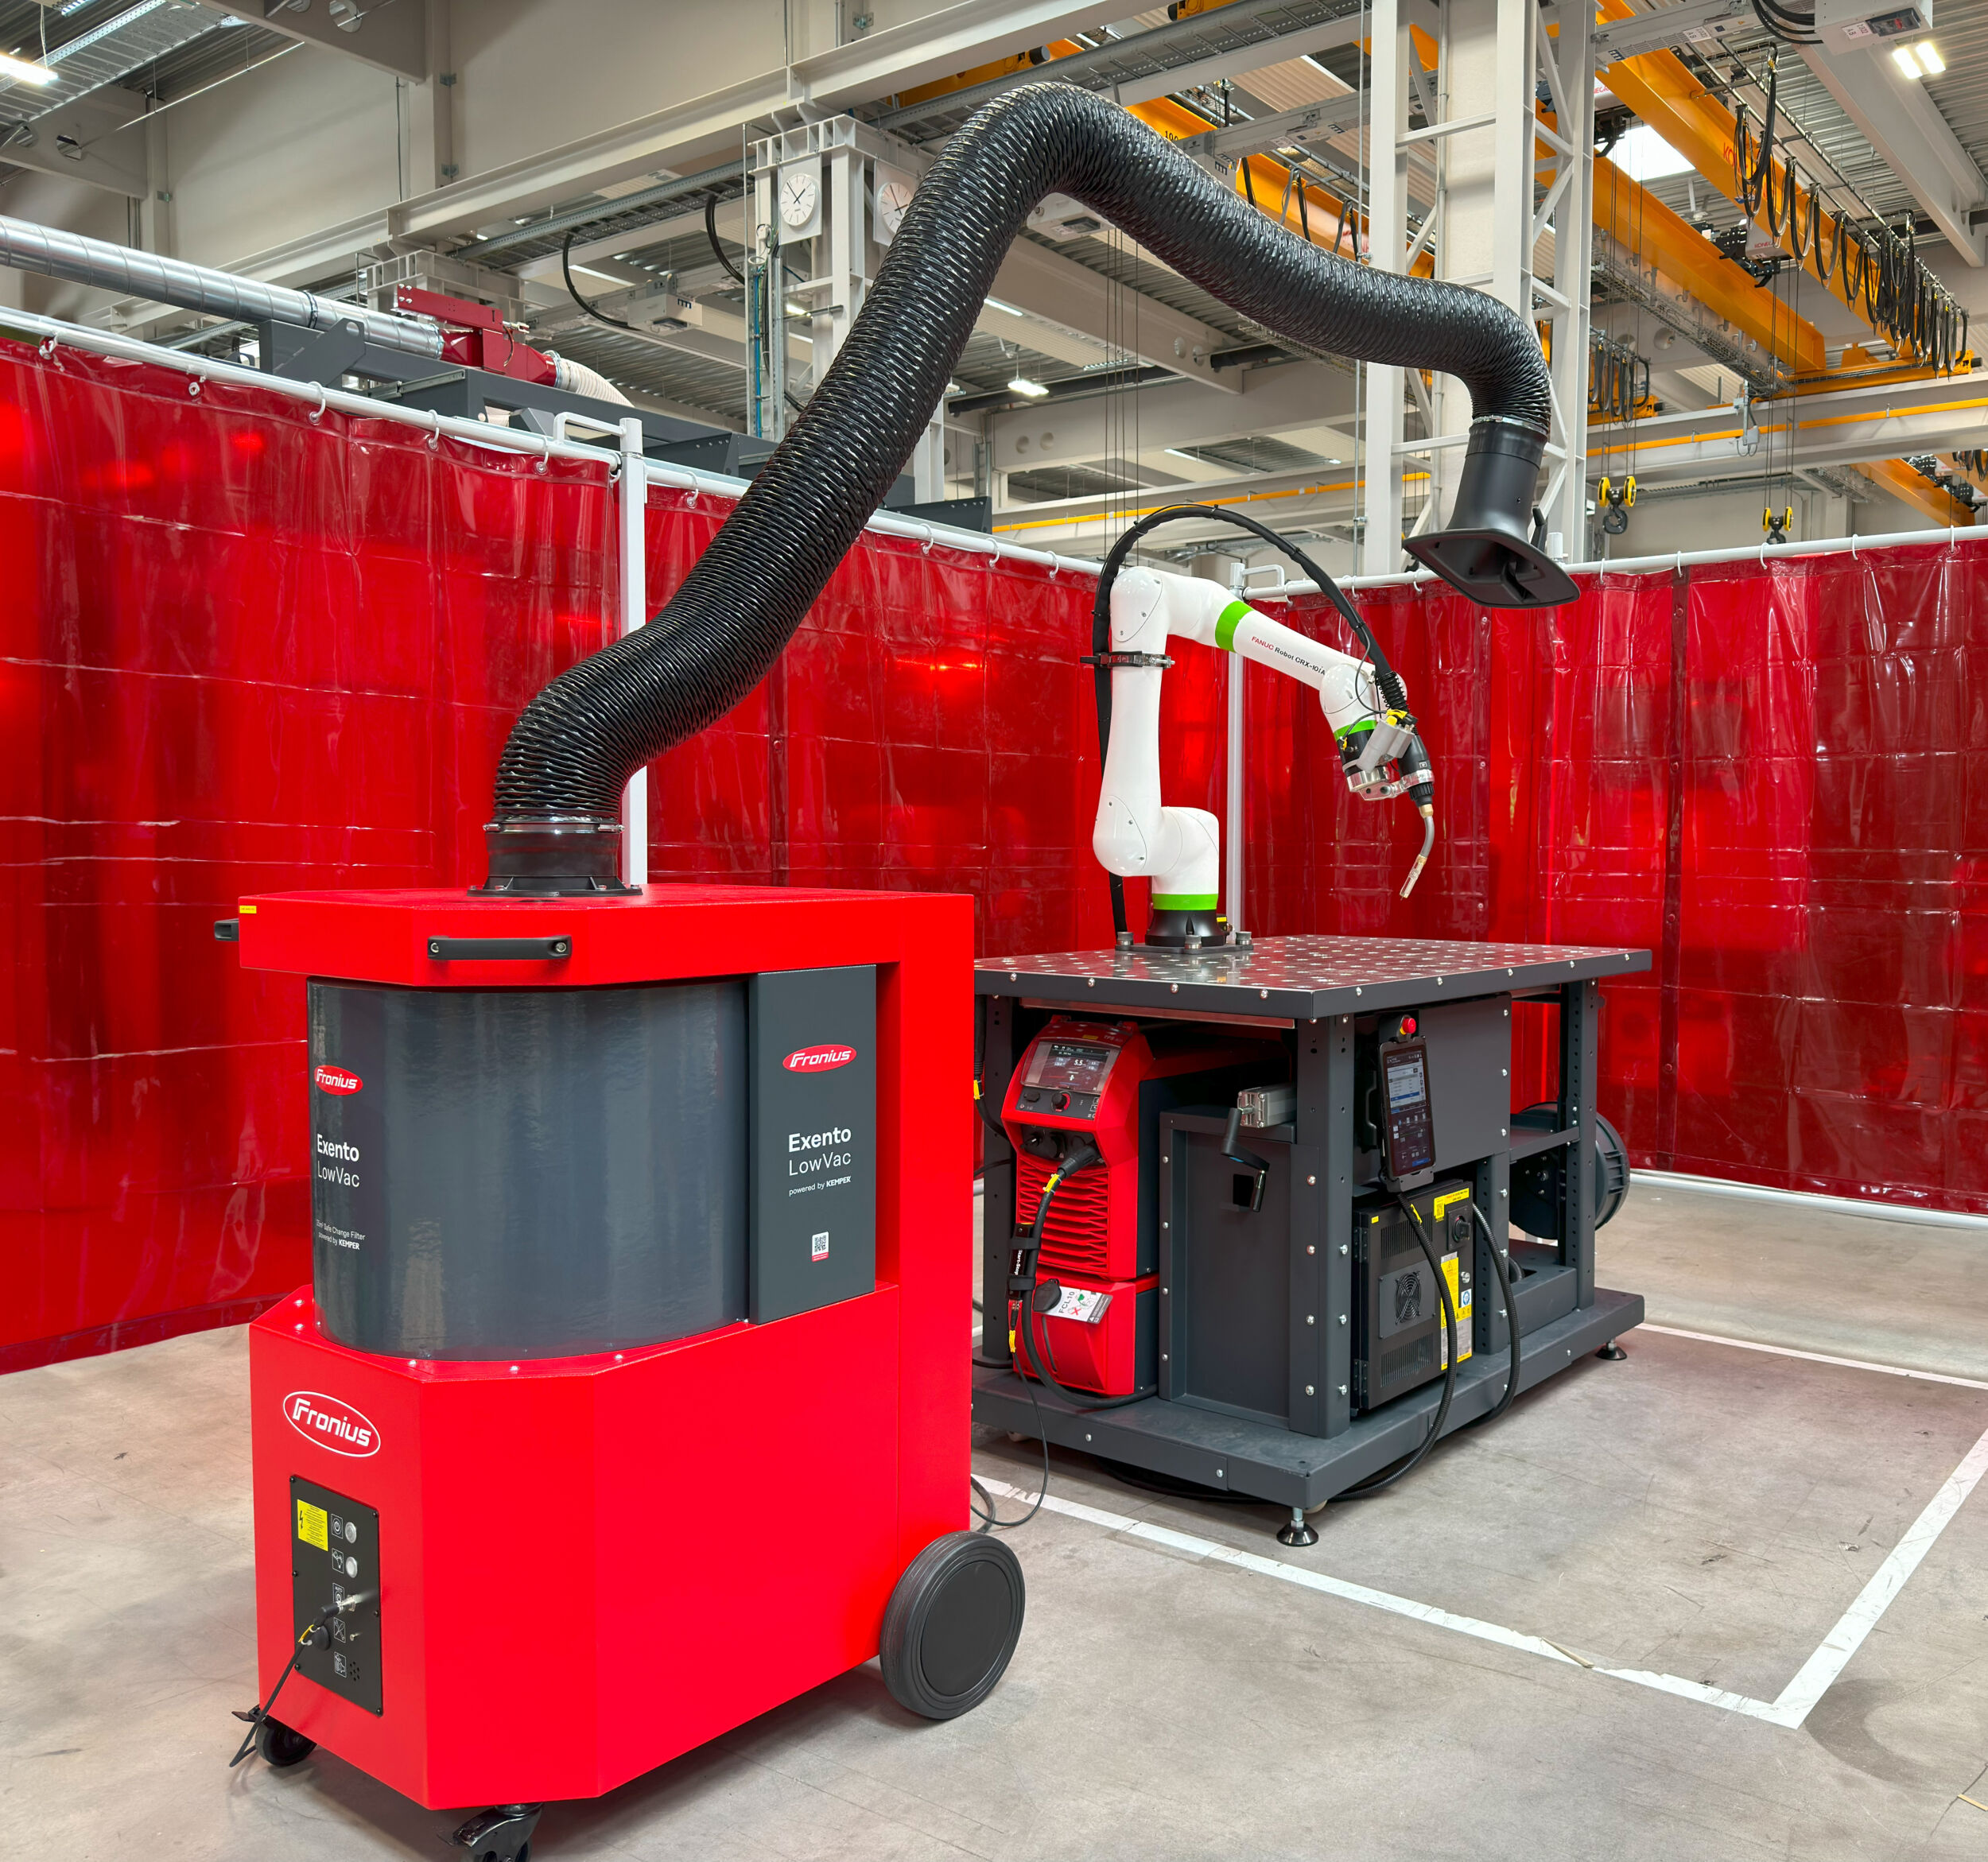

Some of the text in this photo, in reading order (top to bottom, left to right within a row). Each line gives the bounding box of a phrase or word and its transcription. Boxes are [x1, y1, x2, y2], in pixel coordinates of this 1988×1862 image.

[1251, 636, 1274, 650] FANUC
[1274, 646, 1295, 661] Robot
[789, 1049, 852, 1068] Fronius
[316, 1069, 358, 1089] Fronius
[316, 1133, 359, 1162] Exento
[789, 1127, 852, 1153] Exento
[317, 1160, 360, 1187] LowVac
[789, 1151, 852, 1176] LowVac
[789, 1183, 816, 1197] powered
[825, 1176, 852, 1188] KEMPER
[332, 1226, 350, 1239] Change
[350, 1231, 366, 1240] Filter
[332, 1236, 338, 1246] by
[338, 1238, 360, 1251] KEMPER
[1058, 1291, 1075, 1313] FCL10
[292, 1397, 372, 1447] Fronius
